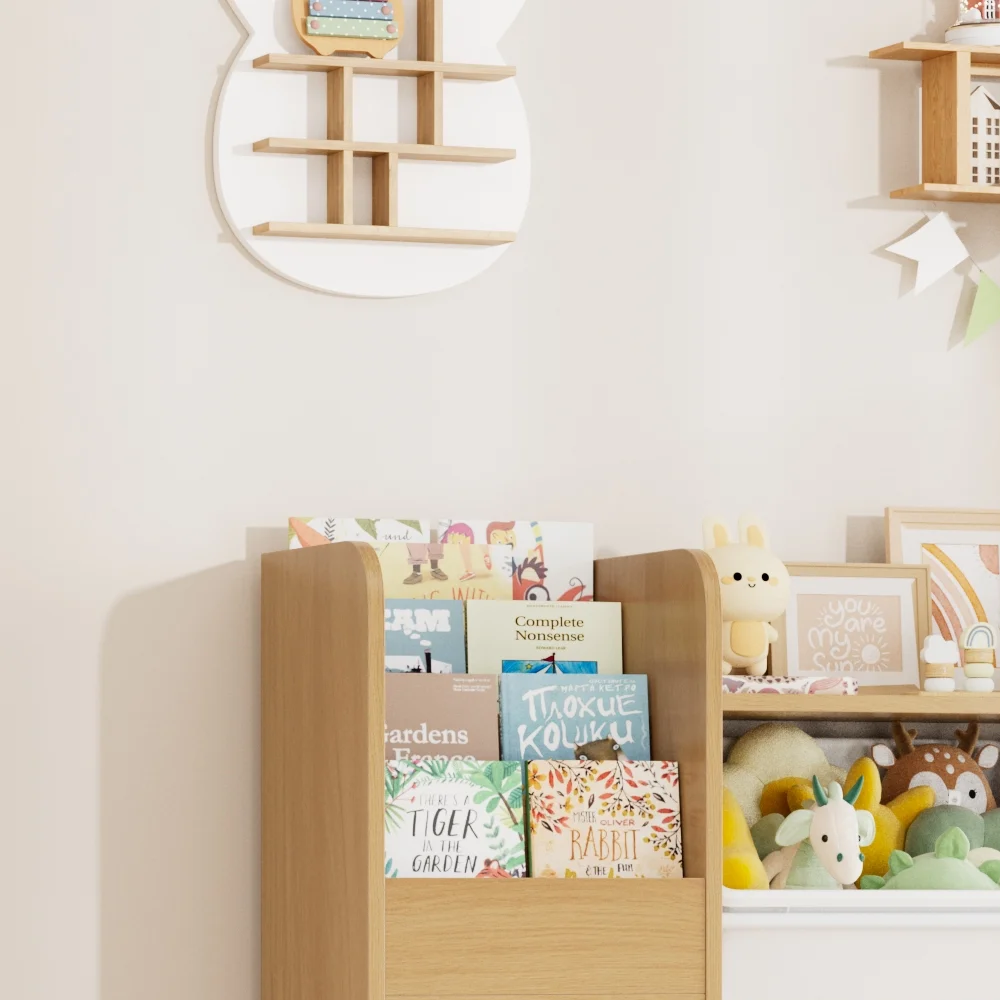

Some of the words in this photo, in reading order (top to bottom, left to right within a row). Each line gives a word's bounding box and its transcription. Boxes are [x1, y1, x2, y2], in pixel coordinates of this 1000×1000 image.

[384, 529, 412, 541] und
[824, 597, 873, 629] you
[515, 616, 584, 630] Complete
[844, 616, 887, 633] are
[515, 630, 585, 641] Nonsense
[407, 808, 478, 839] TIGER
[422, 840, 433, 853] IN
[441, 840, 463, 853] THE
[570, 826, 641, 861] RABBIT
[412, 854, 477, 873] GARDEN
[593, 866, 607, 876] THE
